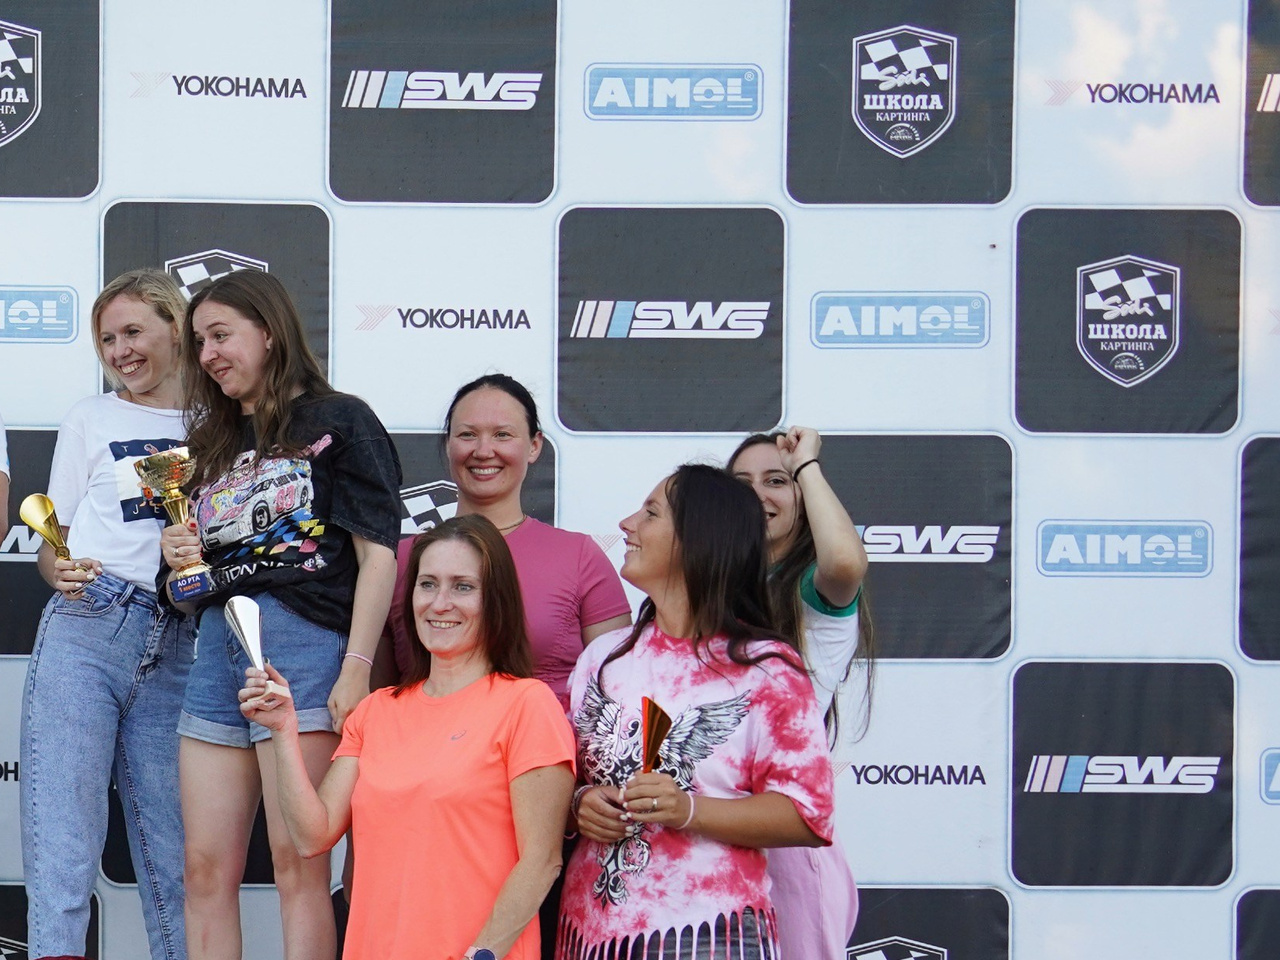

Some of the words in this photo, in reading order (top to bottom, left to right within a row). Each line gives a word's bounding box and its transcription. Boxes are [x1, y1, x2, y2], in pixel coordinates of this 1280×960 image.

[172, 75, 306, 99] YOKOHAMA
[401, 72, 543, 109] SWS
[592, 78, 753, 108] AIMOL
[1086, 83, 1220, 104] YOKOHAMA
[864, 95, 943, 110] ШКОЛА
[876, 112, 930, 121] КАРТИНГА
[398, 307, 531, 330] YOKOHAMA
[630, 301, 770, 338] SWS
[819, 306, 980, 336] AIMOL
[1089, 324, 1166, 339] ШКОЛА
[1101, 342, 1154, 351] КАРТИНГА
[865, 526, 1000, 562] SWS
[1046, 534, 1203, 565] AIMOL
[852, 765, 986, 786] YOKOHAMA
[1082, 756, 1220, 794] SWS
